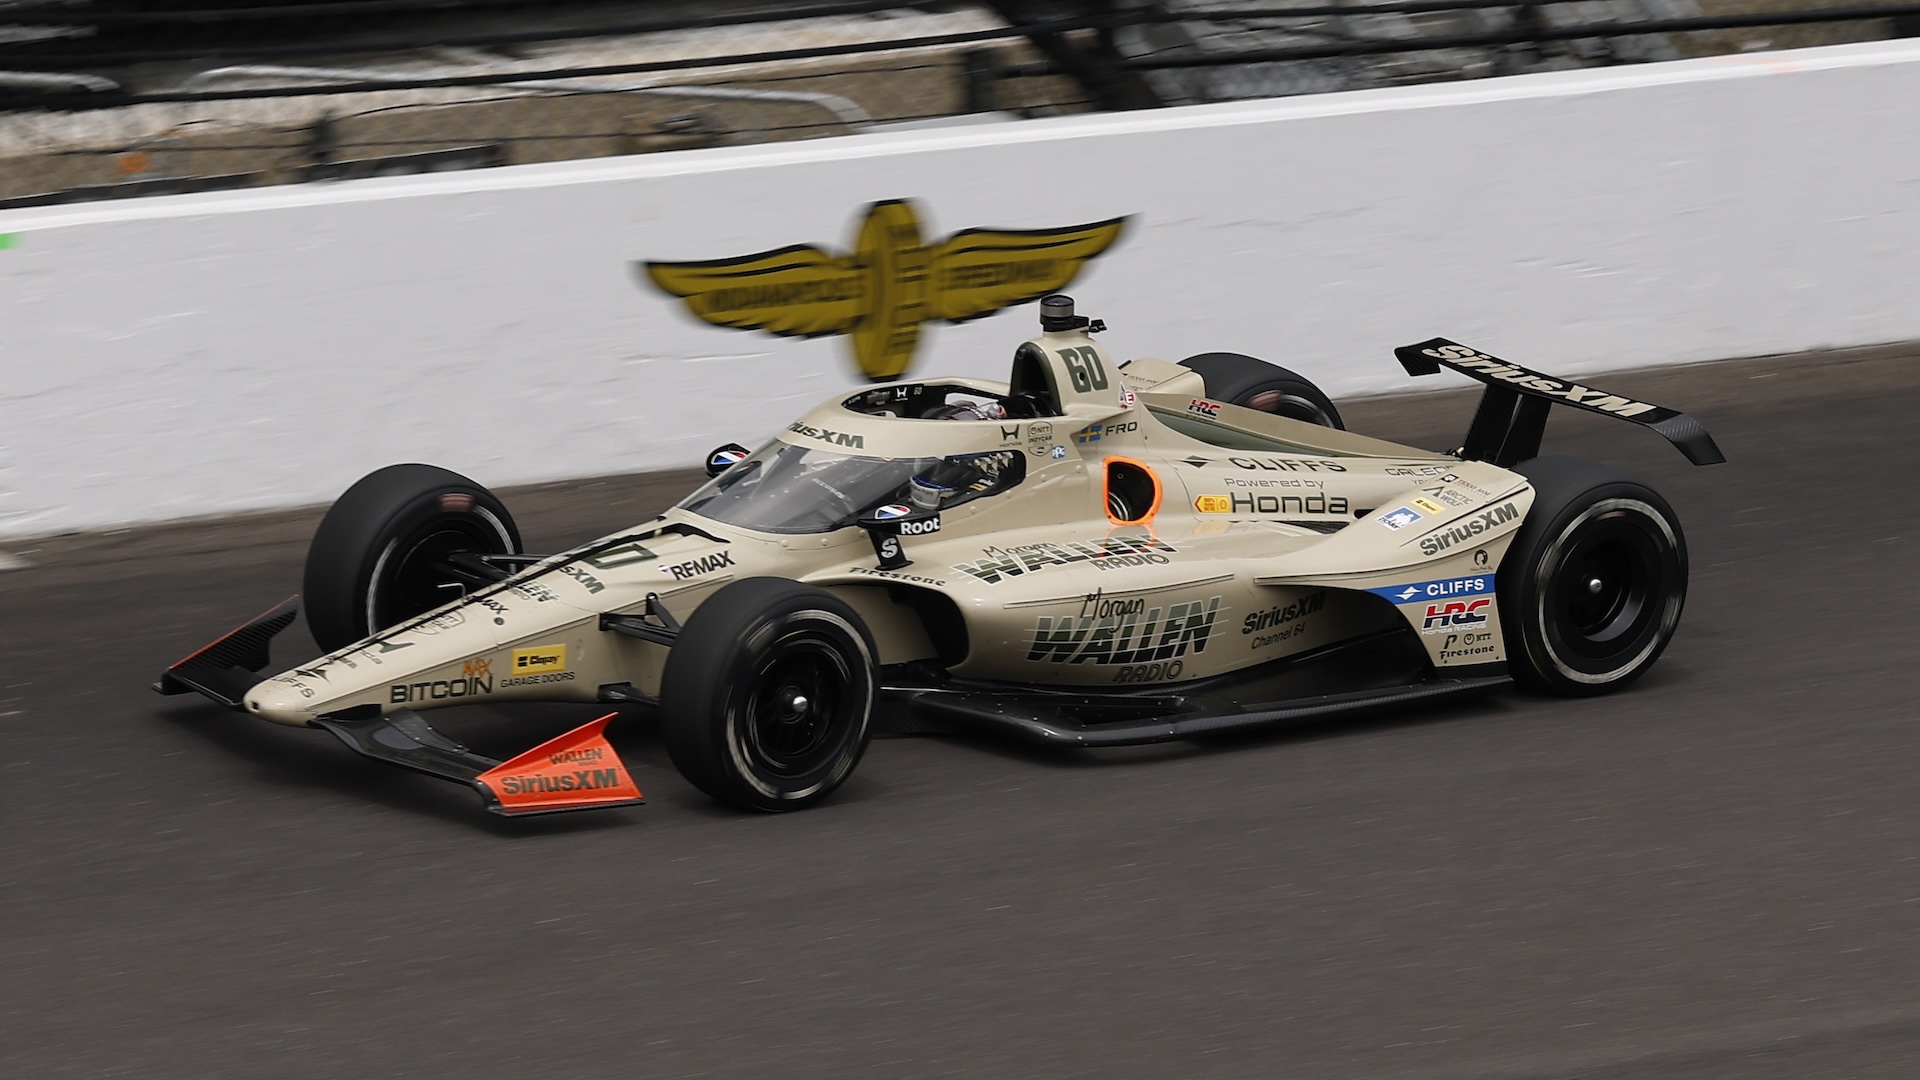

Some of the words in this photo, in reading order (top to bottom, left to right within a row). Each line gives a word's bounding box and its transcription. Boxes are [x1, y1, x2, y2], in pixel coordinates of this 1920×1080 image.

[1055, 345, 1109, 393] 60
[1421, 345, 1658, 417] SiriusXM
[1105, 421, 1138, 436] FRO
[1228, 457, 1348, 472] CLIFFS
[1224, 477, 1301, 488] Powered
[1304, 479, 1324, 490] by
[1230, 491, 1349, 515] Honda
[1440, 494, 1464, 507] WOLF
[1444, 488, 1474, 505] ARCTIC
[900, 517, 940, 535] Root
[1419, 502, 1520, 556] SiriusXM
[950, 534, 1179, 586] WALLEN
[982, 542, 1058, 559] Morgan
[1089, 553, 1170, 571] RADIO
[848, 567, 947, 587] Firestone
[1426, 578, 1485, 596] CLIFFS
[1079, 587, 1145, 634] Morgan
[1241, 590, 1327, 636] SiriusXM
[1421, 598, 1492, 631] HRC
[1025, 595, 1223, 666] WALLEN
[1251, 627, 1291, 651] Channel
[1292, 622, 1306, 639] 64
[1421, 627, 1453, 636] Honda
[1453, 623, 1487, 633] RACING
[1476, 632, 1492, 641] NTT
[1439, 645, 1495, 660] Firestone
[501, 675, 540, 688] GARAGE
[542, 671, 575, 683] DOORS
[1112, 660, 1184, 684] RADIO
[390, 673, 494, 703] BITCOIN
[548, 748, 603, 765] WALLEN
[501, 768, 620, 795] SiriusXM
